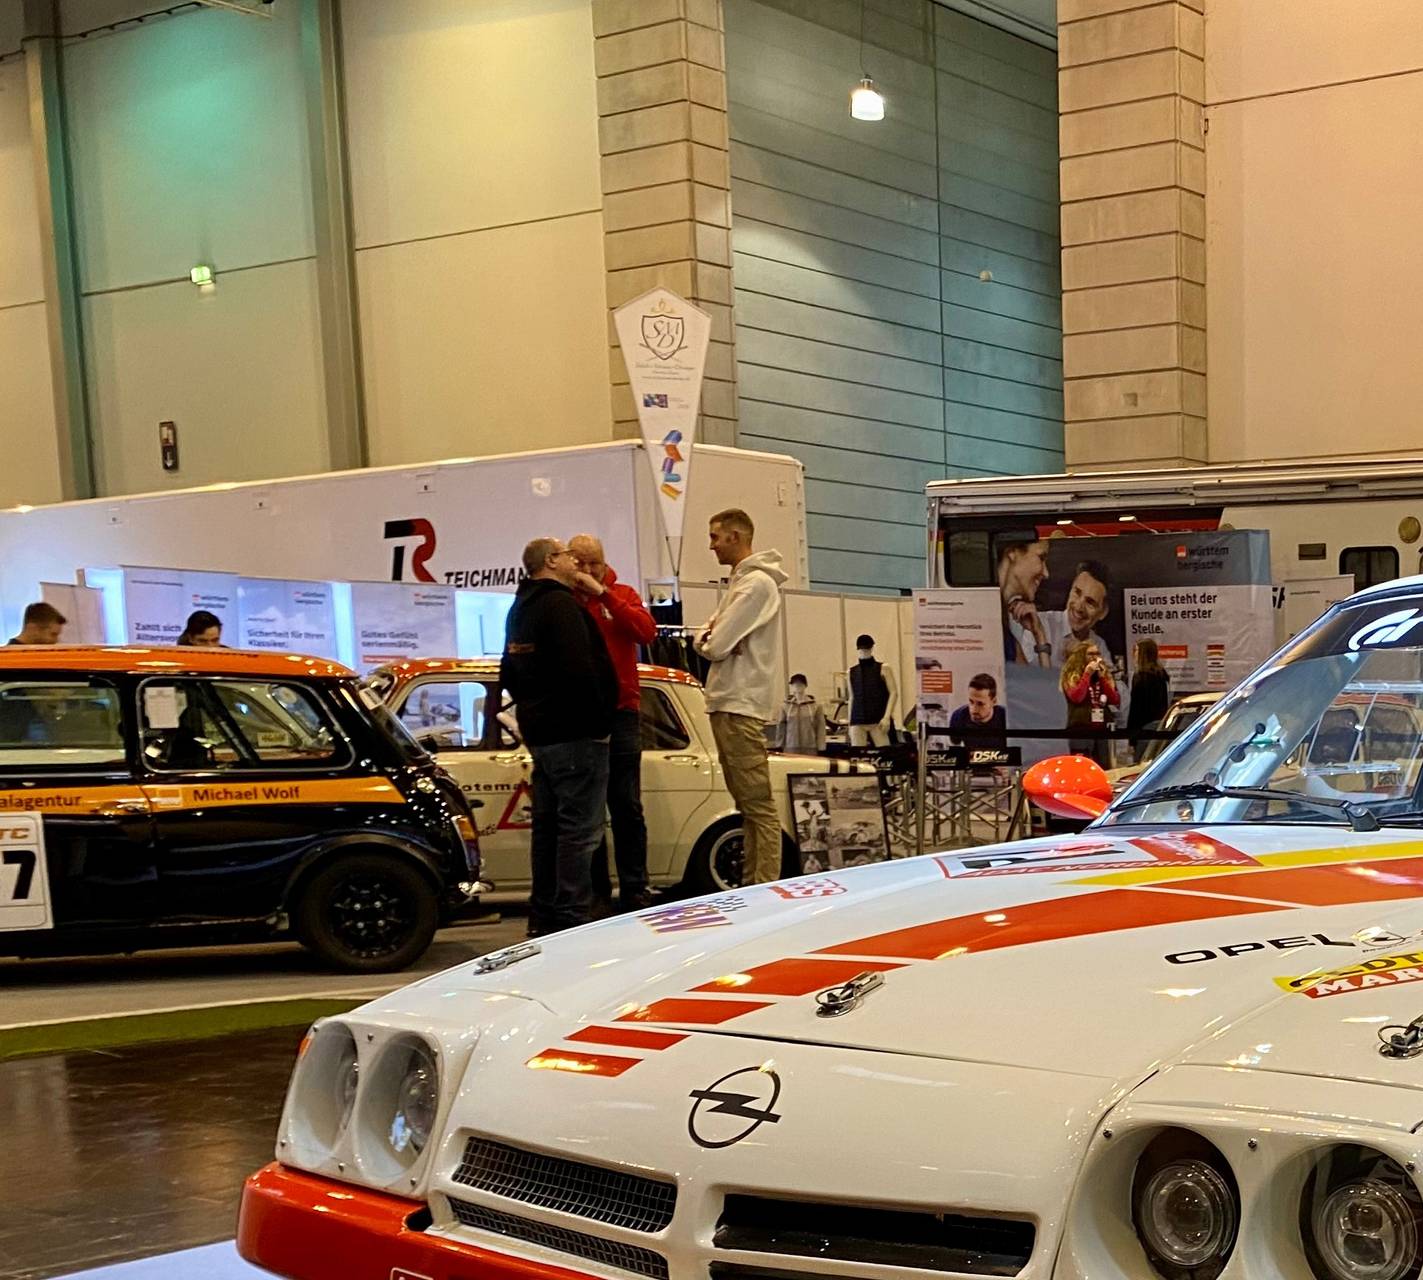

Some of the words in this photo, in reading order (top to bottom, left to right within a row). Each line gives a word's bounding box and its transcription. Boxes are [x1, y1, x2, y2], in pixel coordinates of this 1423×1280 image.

[1131, 595, 1147, 606] Bei
[1149, 596, 1168, 606] uns
[1170, 594, 1198, 605] steht
[1200, 593, 1217, 604] der
[1131, 609, 1163, 620] Kunde
[1166, 611, 1178, 620] an
[1181, 609, 1212, 619] erster
[1132, 623, 1165, 635] Stelle.
[973, 750, 999, 761] DSK
[193, 786, 258, 801] Michael
[262, 785, 300, 800] Wolf
[2, 849, 37, 900] 7
[1164, 933, 1356, 965] OPEL
